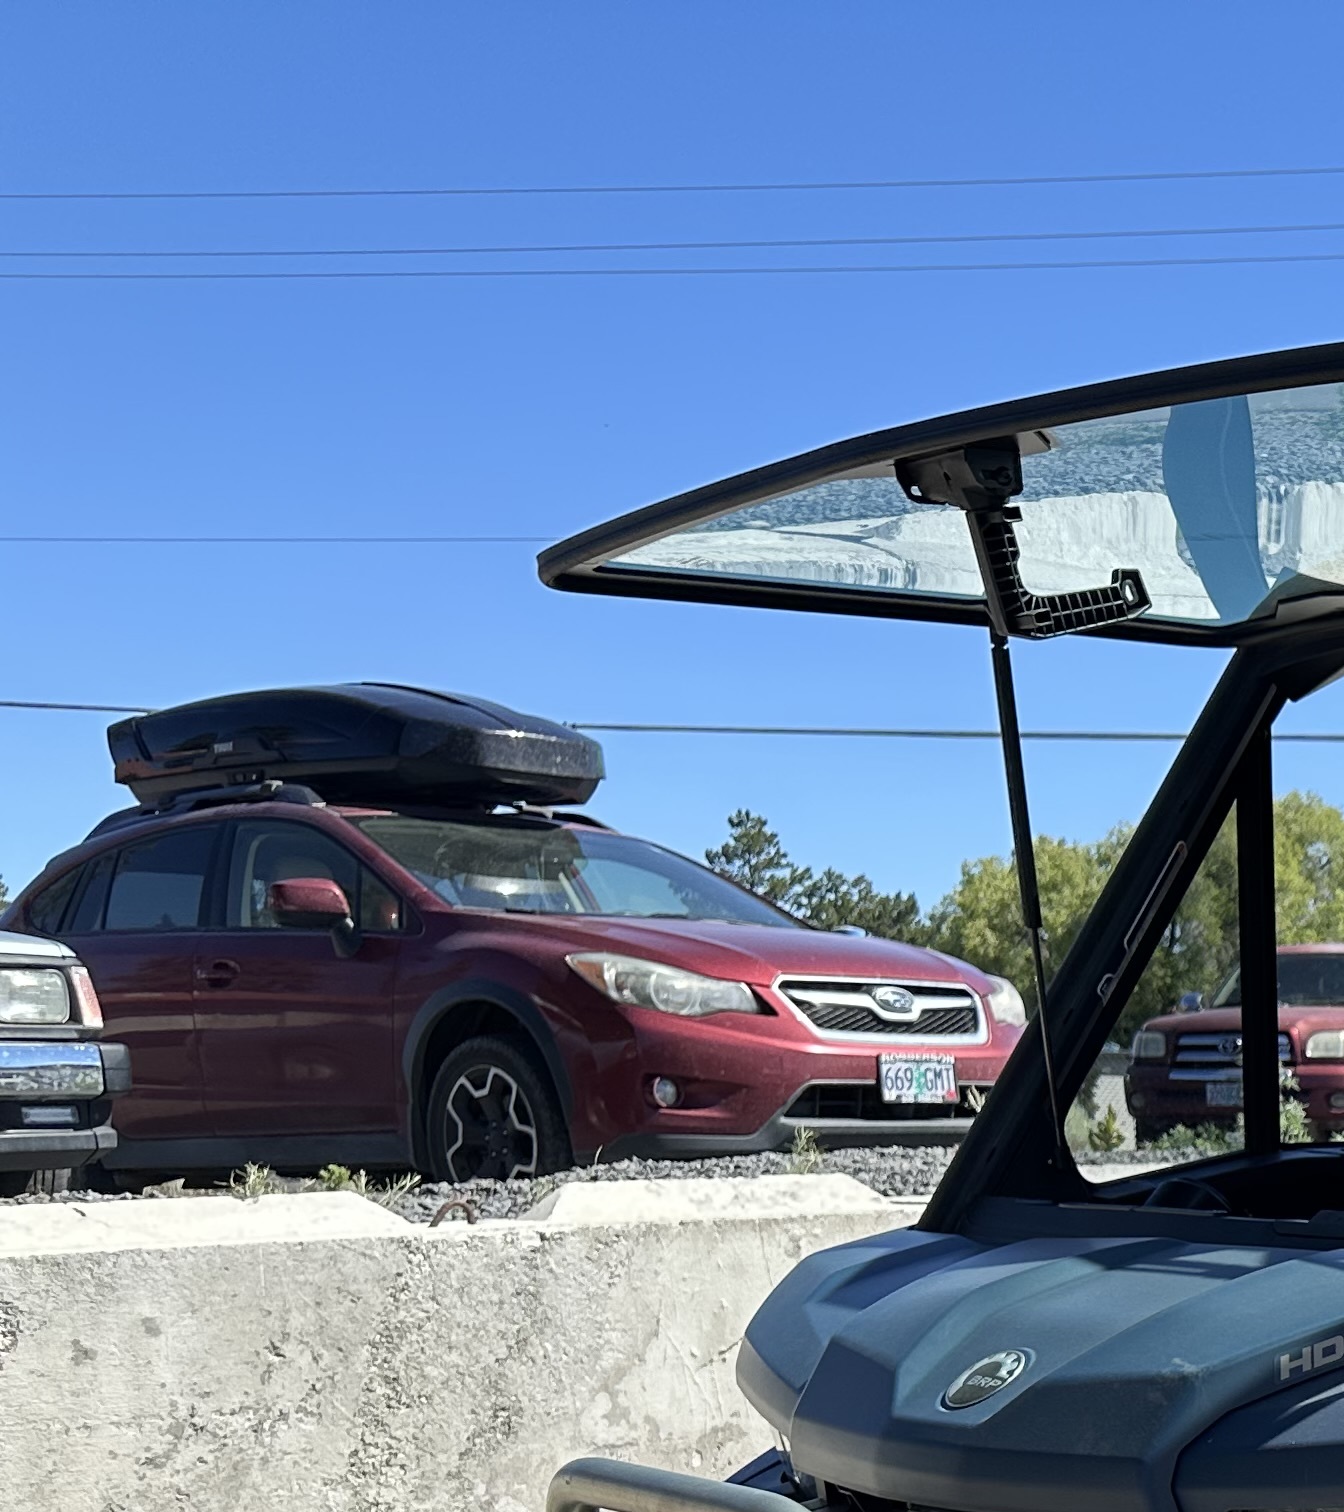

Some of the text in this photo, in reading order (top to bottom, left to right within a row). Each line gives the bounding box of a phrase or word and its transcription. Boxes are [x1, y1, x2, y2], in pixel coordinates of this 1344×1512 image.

[884, 1066, 952, 1091] 669 GMT
[965, 1374, 1003, 1389] BRP
